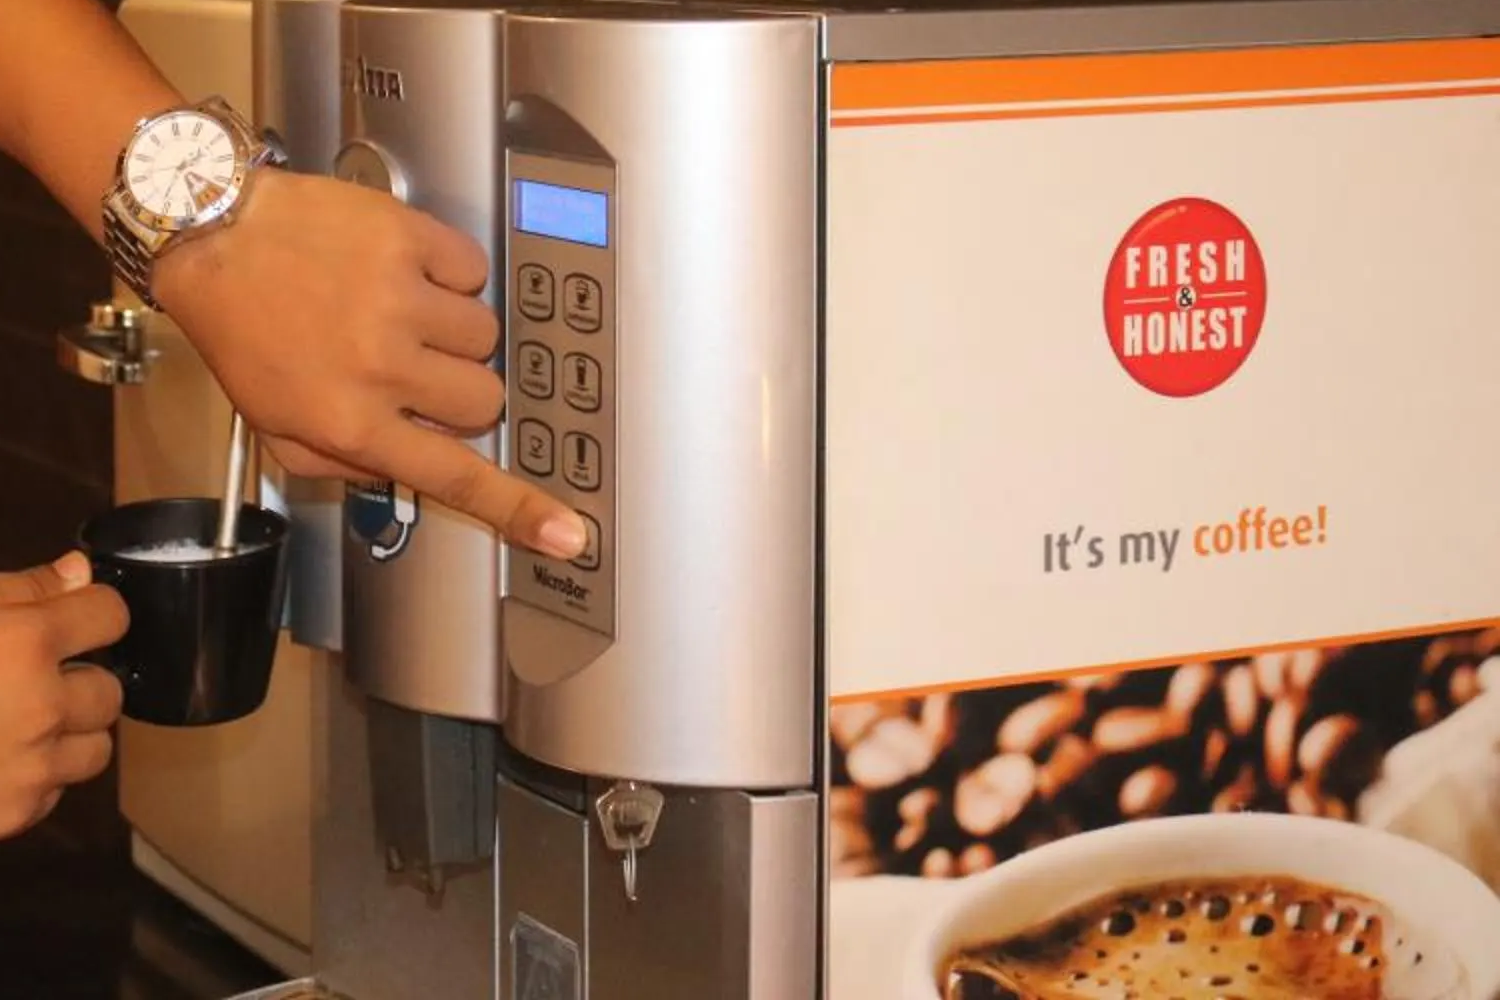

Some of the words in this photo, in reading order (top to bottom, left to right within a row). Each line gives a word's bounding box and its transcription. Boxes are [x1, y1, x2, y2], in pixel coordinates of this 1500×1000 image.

[1125, 238, 1246, 289] FRESH
[1178, 286, 1193, 308] &
[1123, 306, 1248, 357] HONEST
[1043, 525, 1104, 573] It's
[1119, 529, 1180, 572] my
[1193, 505, 1328, 557] coffee!
